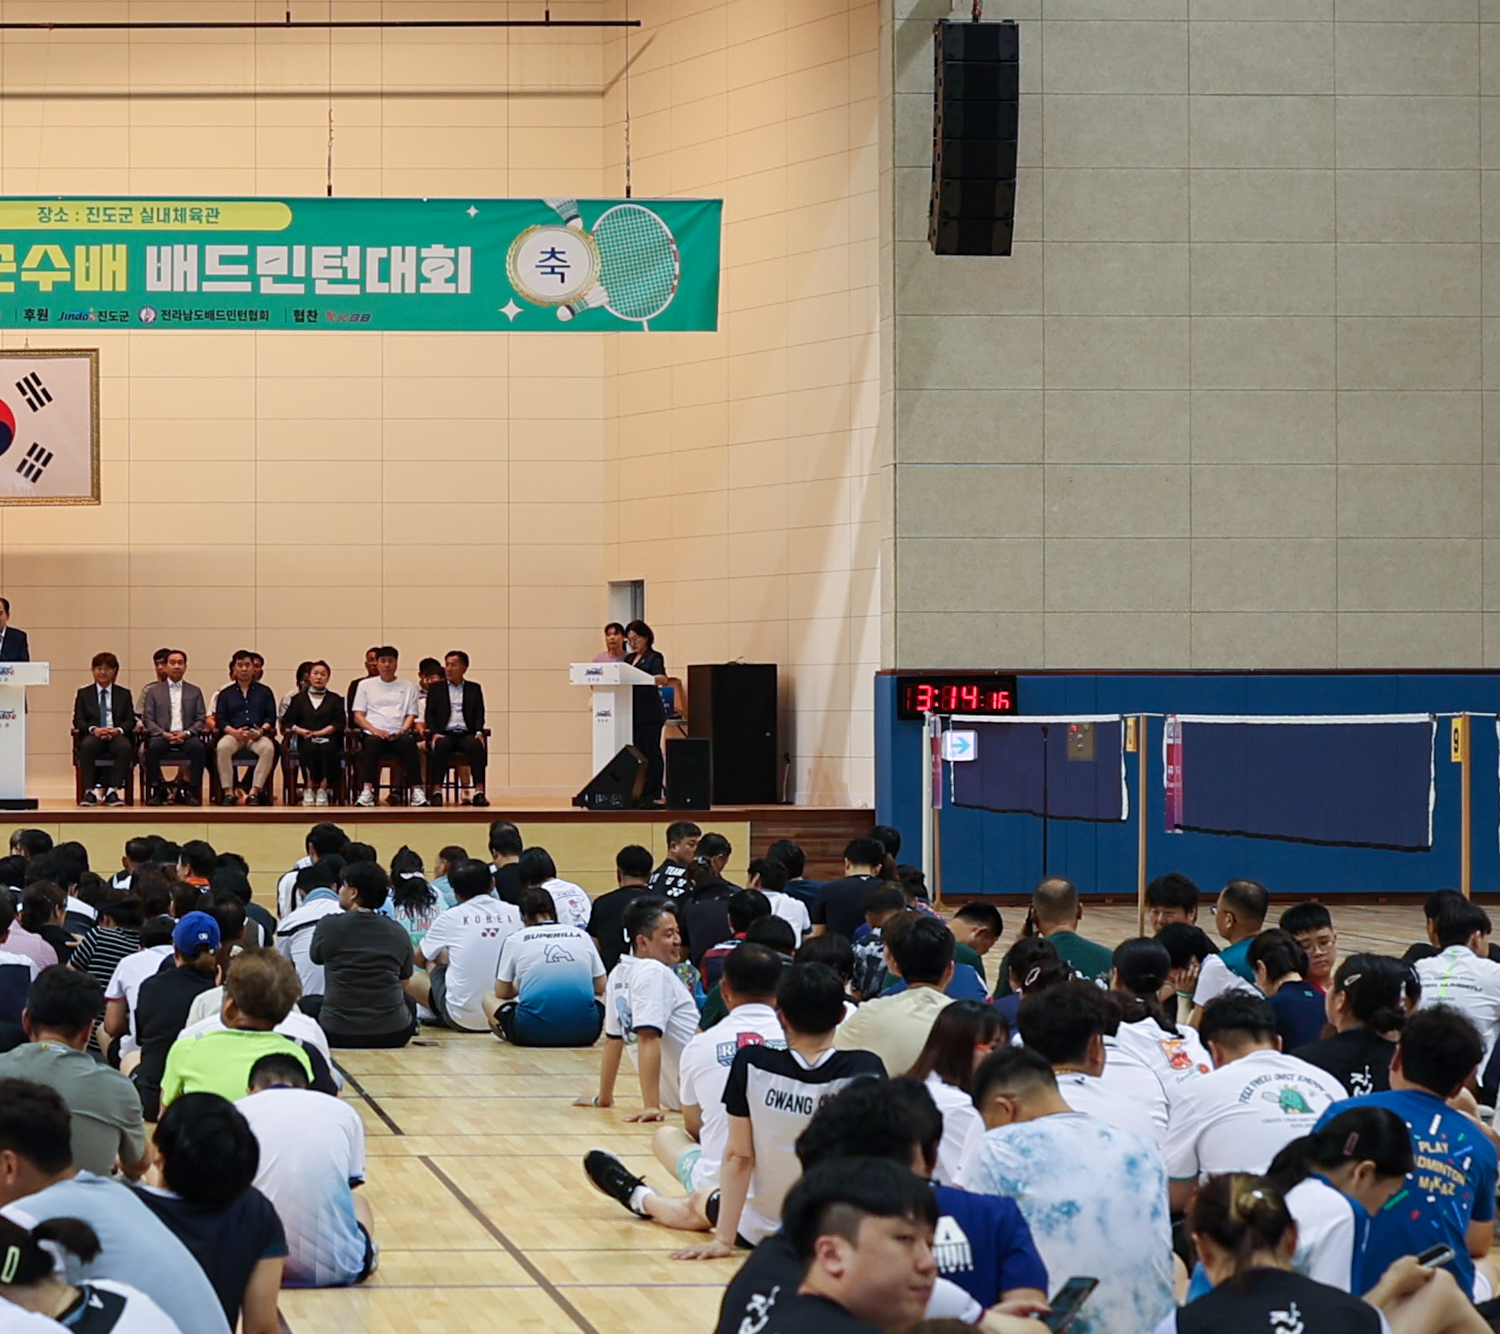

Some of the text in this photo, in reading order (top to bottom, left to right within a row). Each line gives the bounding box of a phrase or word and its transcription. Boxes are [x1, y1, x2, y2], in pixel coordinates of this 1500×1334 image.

[38, 207, 68, 224] 장소
[86, 207, 133, 224] 진도군
[140, 207, 221, 225] 실내체육관
[145, 243, 472, 296] 배드민턴대회
[535, 246, 571, 284] 축
[23, 307, 49, 322] 후원
[96, 309, 130, 323] 진도군
[160, 309, 270, 323] 전라남도배드민턴협회
[293, 308, 319, 323] 협찬
[522, 931, 584, 942] SUPERILLA
[764, 1088, 813, 1115] GWANG
[1417, 1140, 1449, 1155] PLAY
[1413, 1154, 1467, 1187] DMINTON
